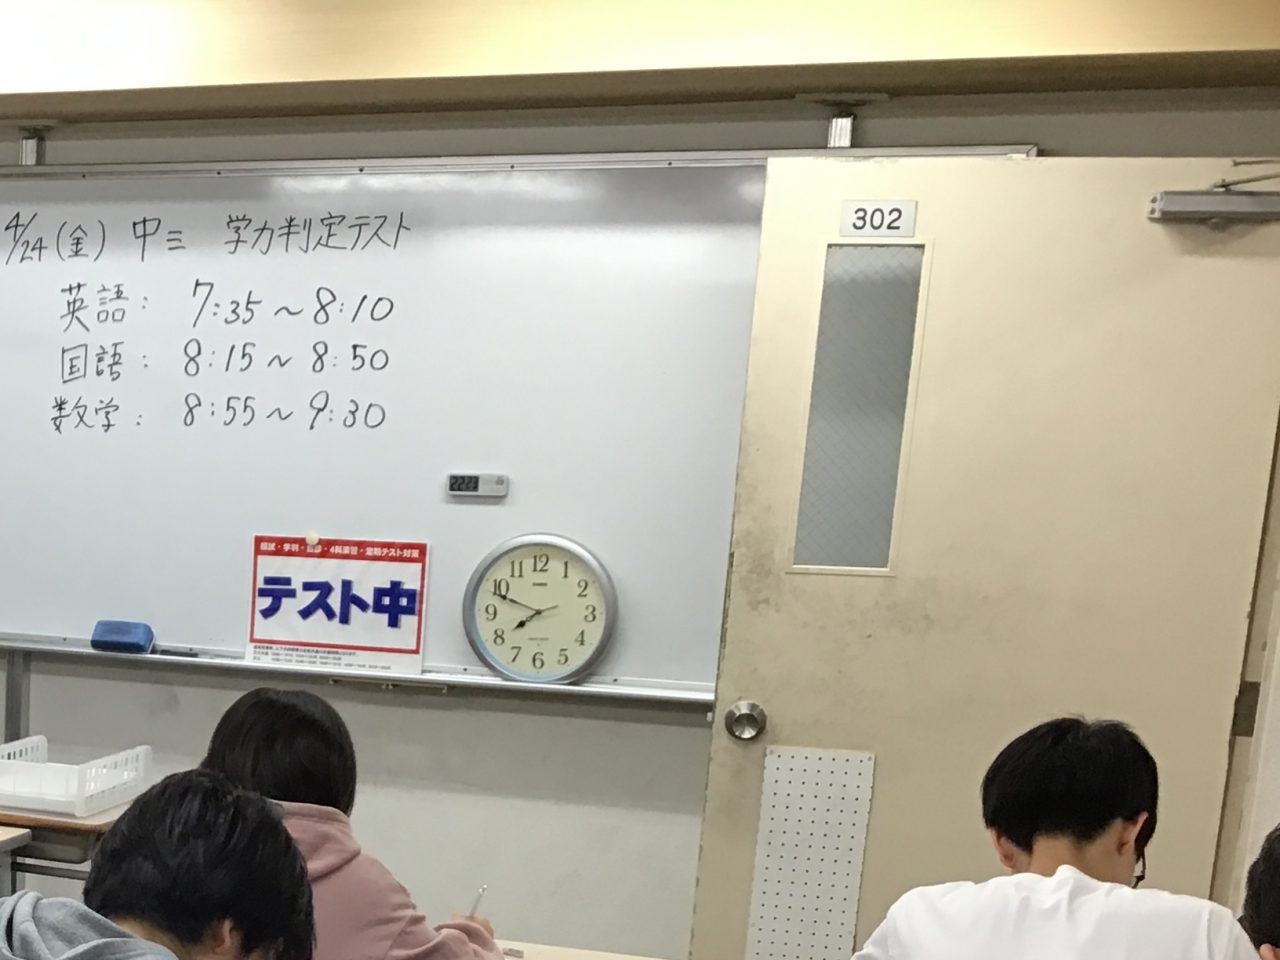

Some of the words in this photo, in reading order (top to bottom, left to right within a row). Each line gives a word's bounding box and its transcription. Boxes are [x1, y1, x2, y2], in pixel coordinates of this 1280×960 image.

[852, 207, 903, 230] 302
[223, 211, 412, 256] 学力判定テスト
[510, 560, 524, 578] 11
[532, 553, 549, 572] 12
[562, 560, 569, 578] 1
[492, 578, 510, 597] 10
[577, 579, 589, 597] 2
[257, 575, 419, 629] テスト中
[485, 603, 498, 621] 9
[584, 604, 597, 622] 3
[493, 628, 505, 646] 8
[574, 629, 585, 646] 4
[511, 646, 522, 663] 7
[532, 651, 545, 669] 6
[557, 648, 569, 665] 5
